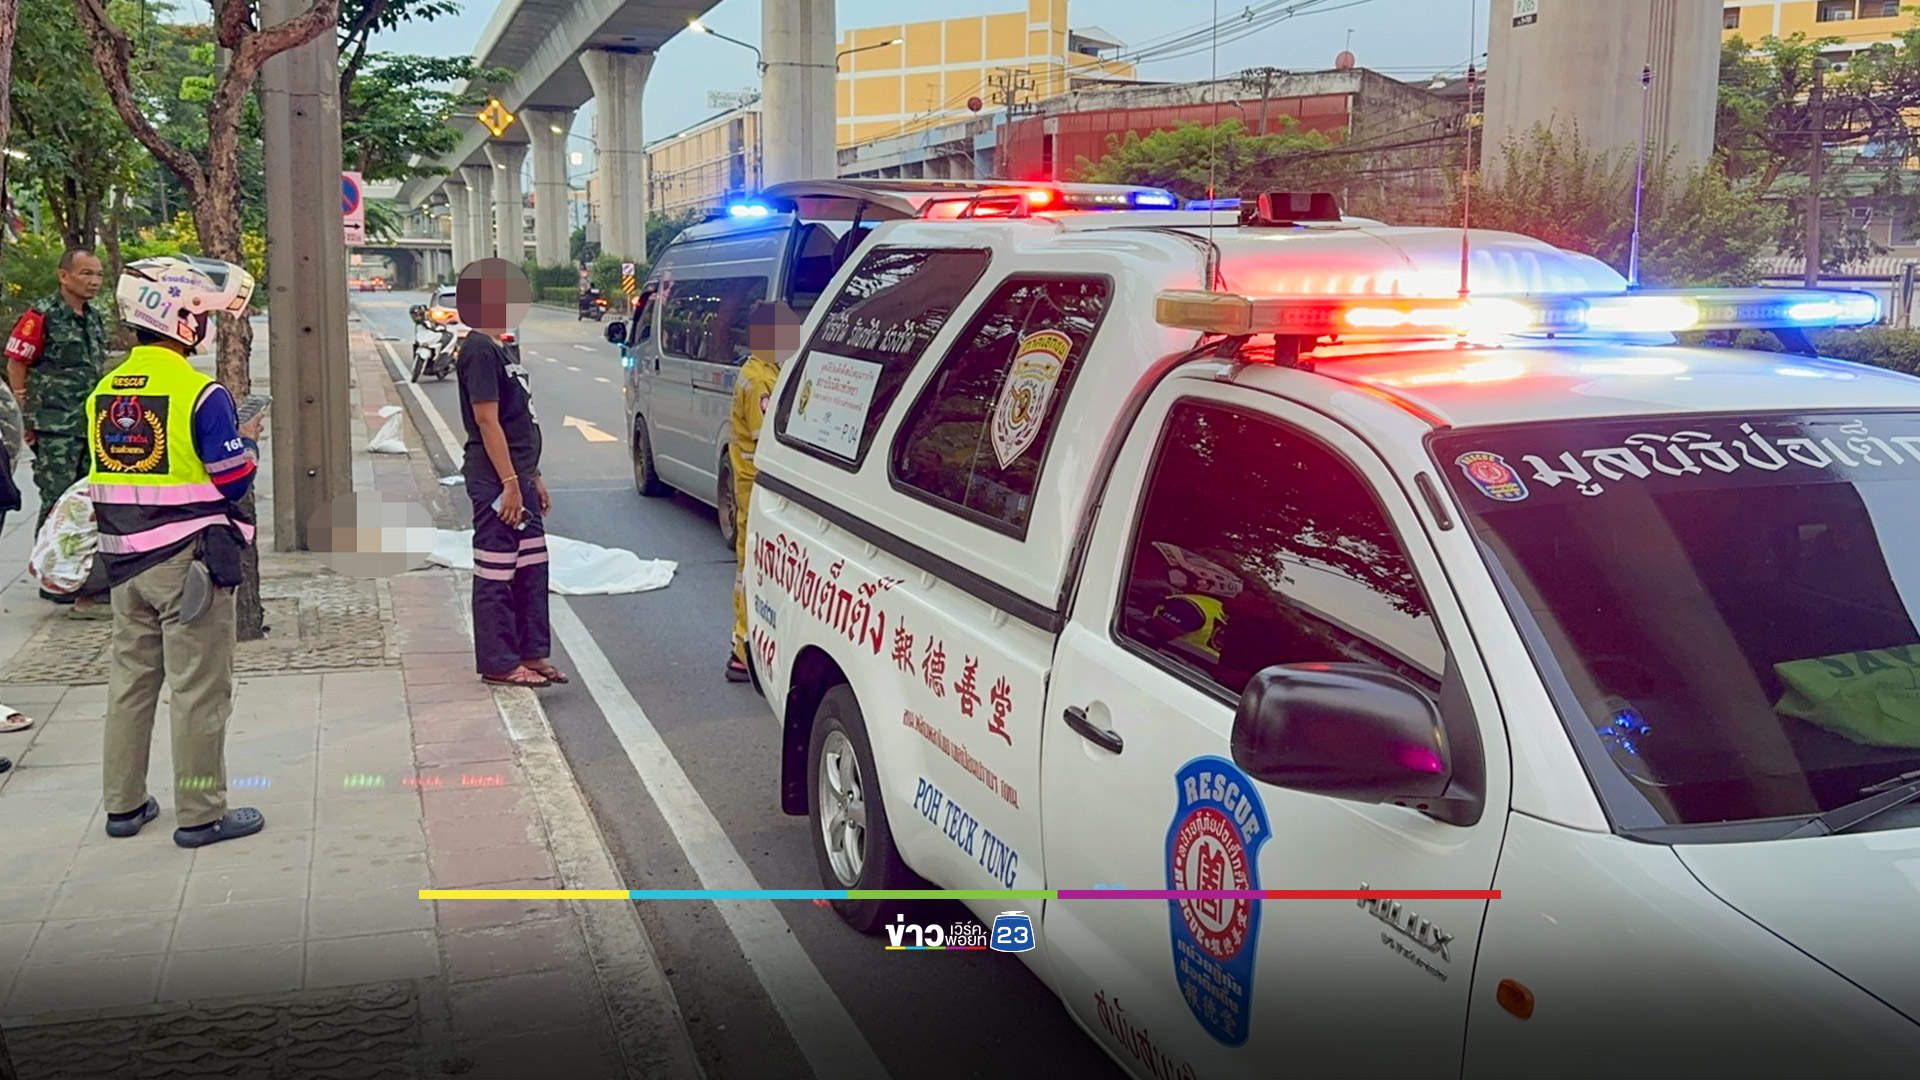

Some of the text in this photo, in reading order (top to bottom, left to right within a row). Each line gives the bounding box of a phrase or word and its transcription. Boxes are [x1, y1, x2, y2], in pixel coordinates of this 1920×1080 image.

[113, 376, 146, 387] RESCUE
[892, 616, 1012, 746] 報德善堂
[914, 777, 1018, 890] POH TECK TUNG
[1184, 771, 1261, 845] RESCUE
